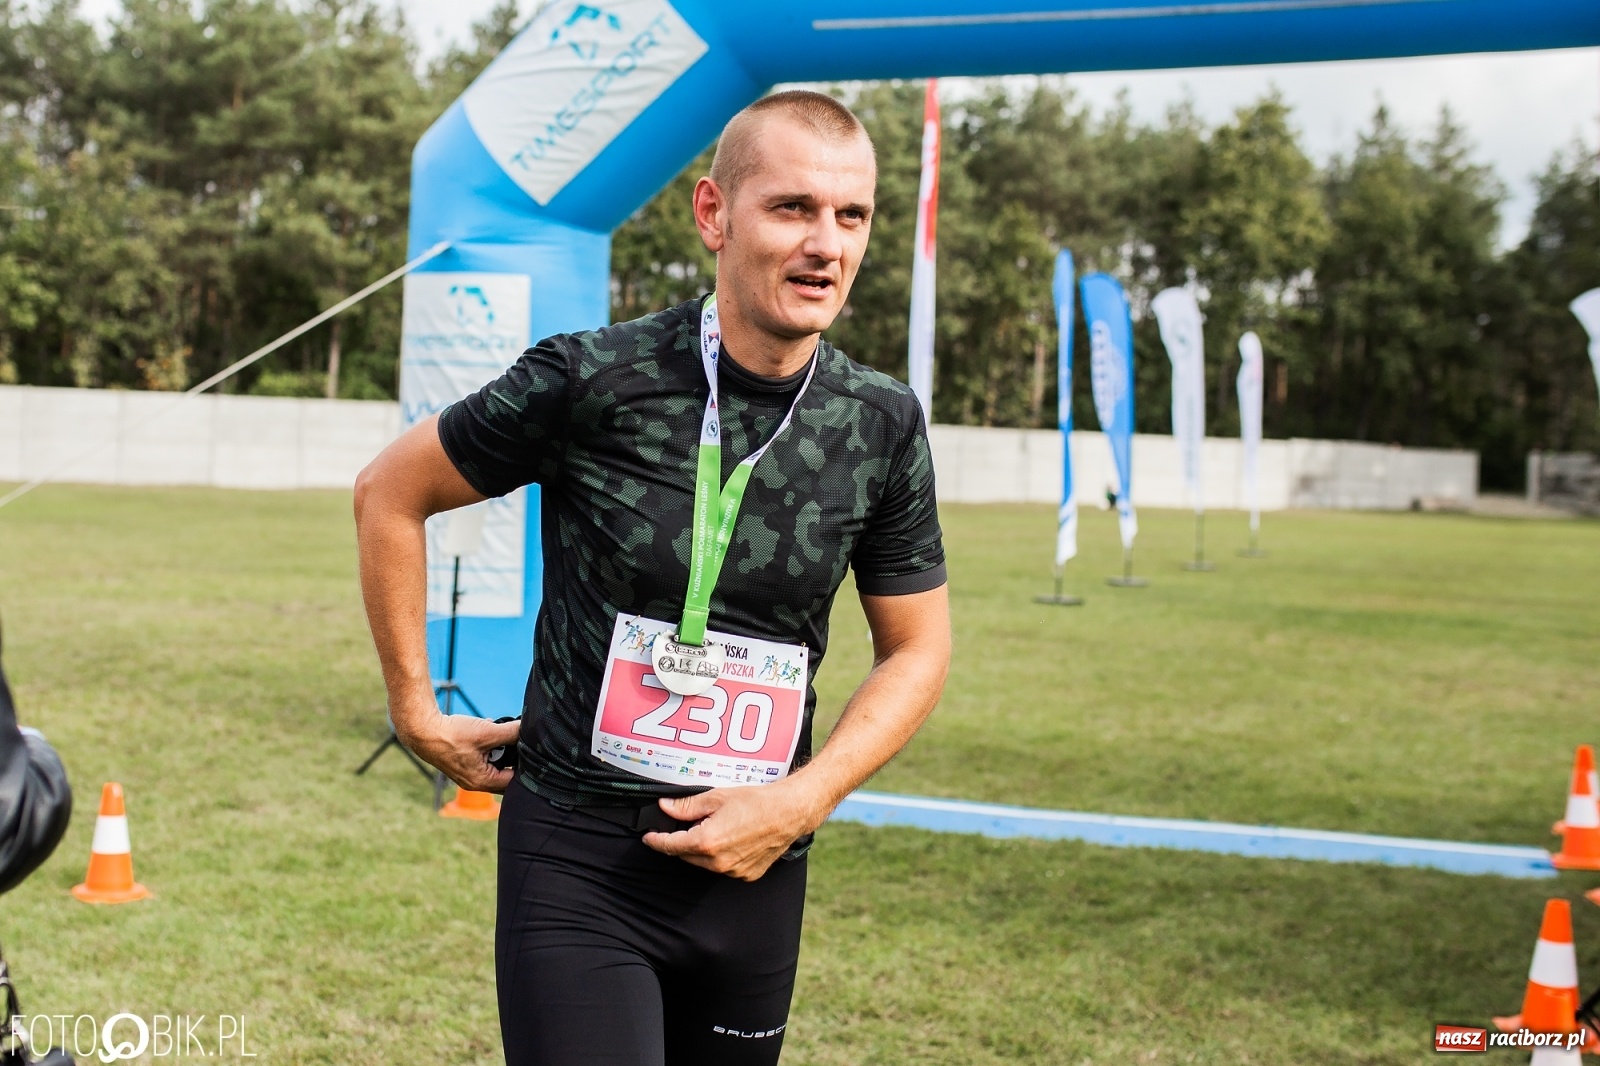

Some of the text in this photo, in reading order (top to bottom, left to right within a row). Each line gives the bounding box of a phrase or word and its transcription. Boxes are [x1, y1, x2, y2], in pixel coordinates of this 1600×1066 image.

[510, 12, 671, 172] TIMESPORT
[706, 525, 715, 557] RAFAMET
[631, 672, 774, 754] 230
